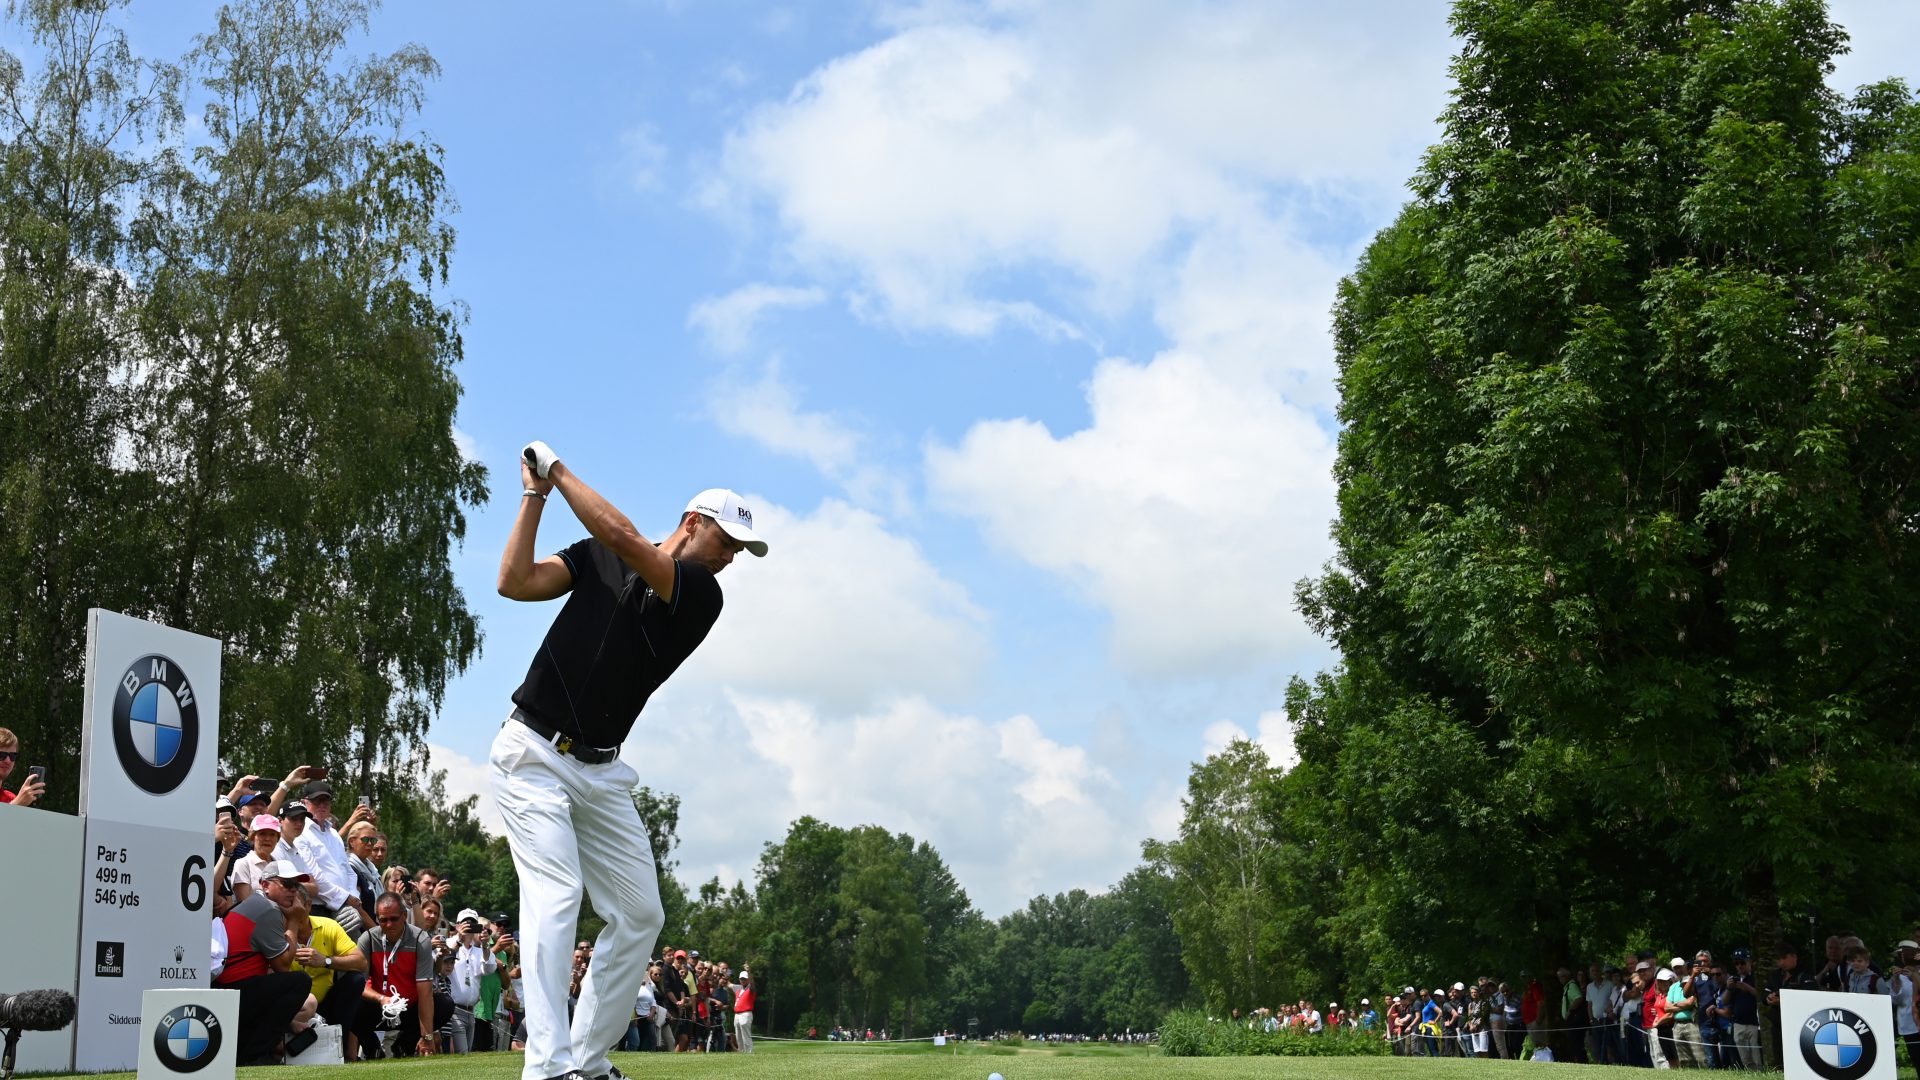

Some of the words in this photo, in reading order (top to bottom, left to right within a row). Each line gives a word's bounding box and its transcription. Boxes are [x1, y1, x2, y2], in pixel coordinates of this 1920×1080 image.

[122, 658, 194, 708] BMW
[97, 845, 117, 862] Par
[119, 848, 127, 863] 5
[95, 867, 118, 884] 499
[120, 872, 131, 884] m
[181, 854, 207, 912] 6
[94, 888, 117, 905] 546
[119, 891, 140, 909] yds
[97, 964, 122, 974] Emirates
[160, 967, 197, 980] ROLEX
[162, 1006, 218, 1028] BMW
[1805, 1009, 1870, 1035] BMW
